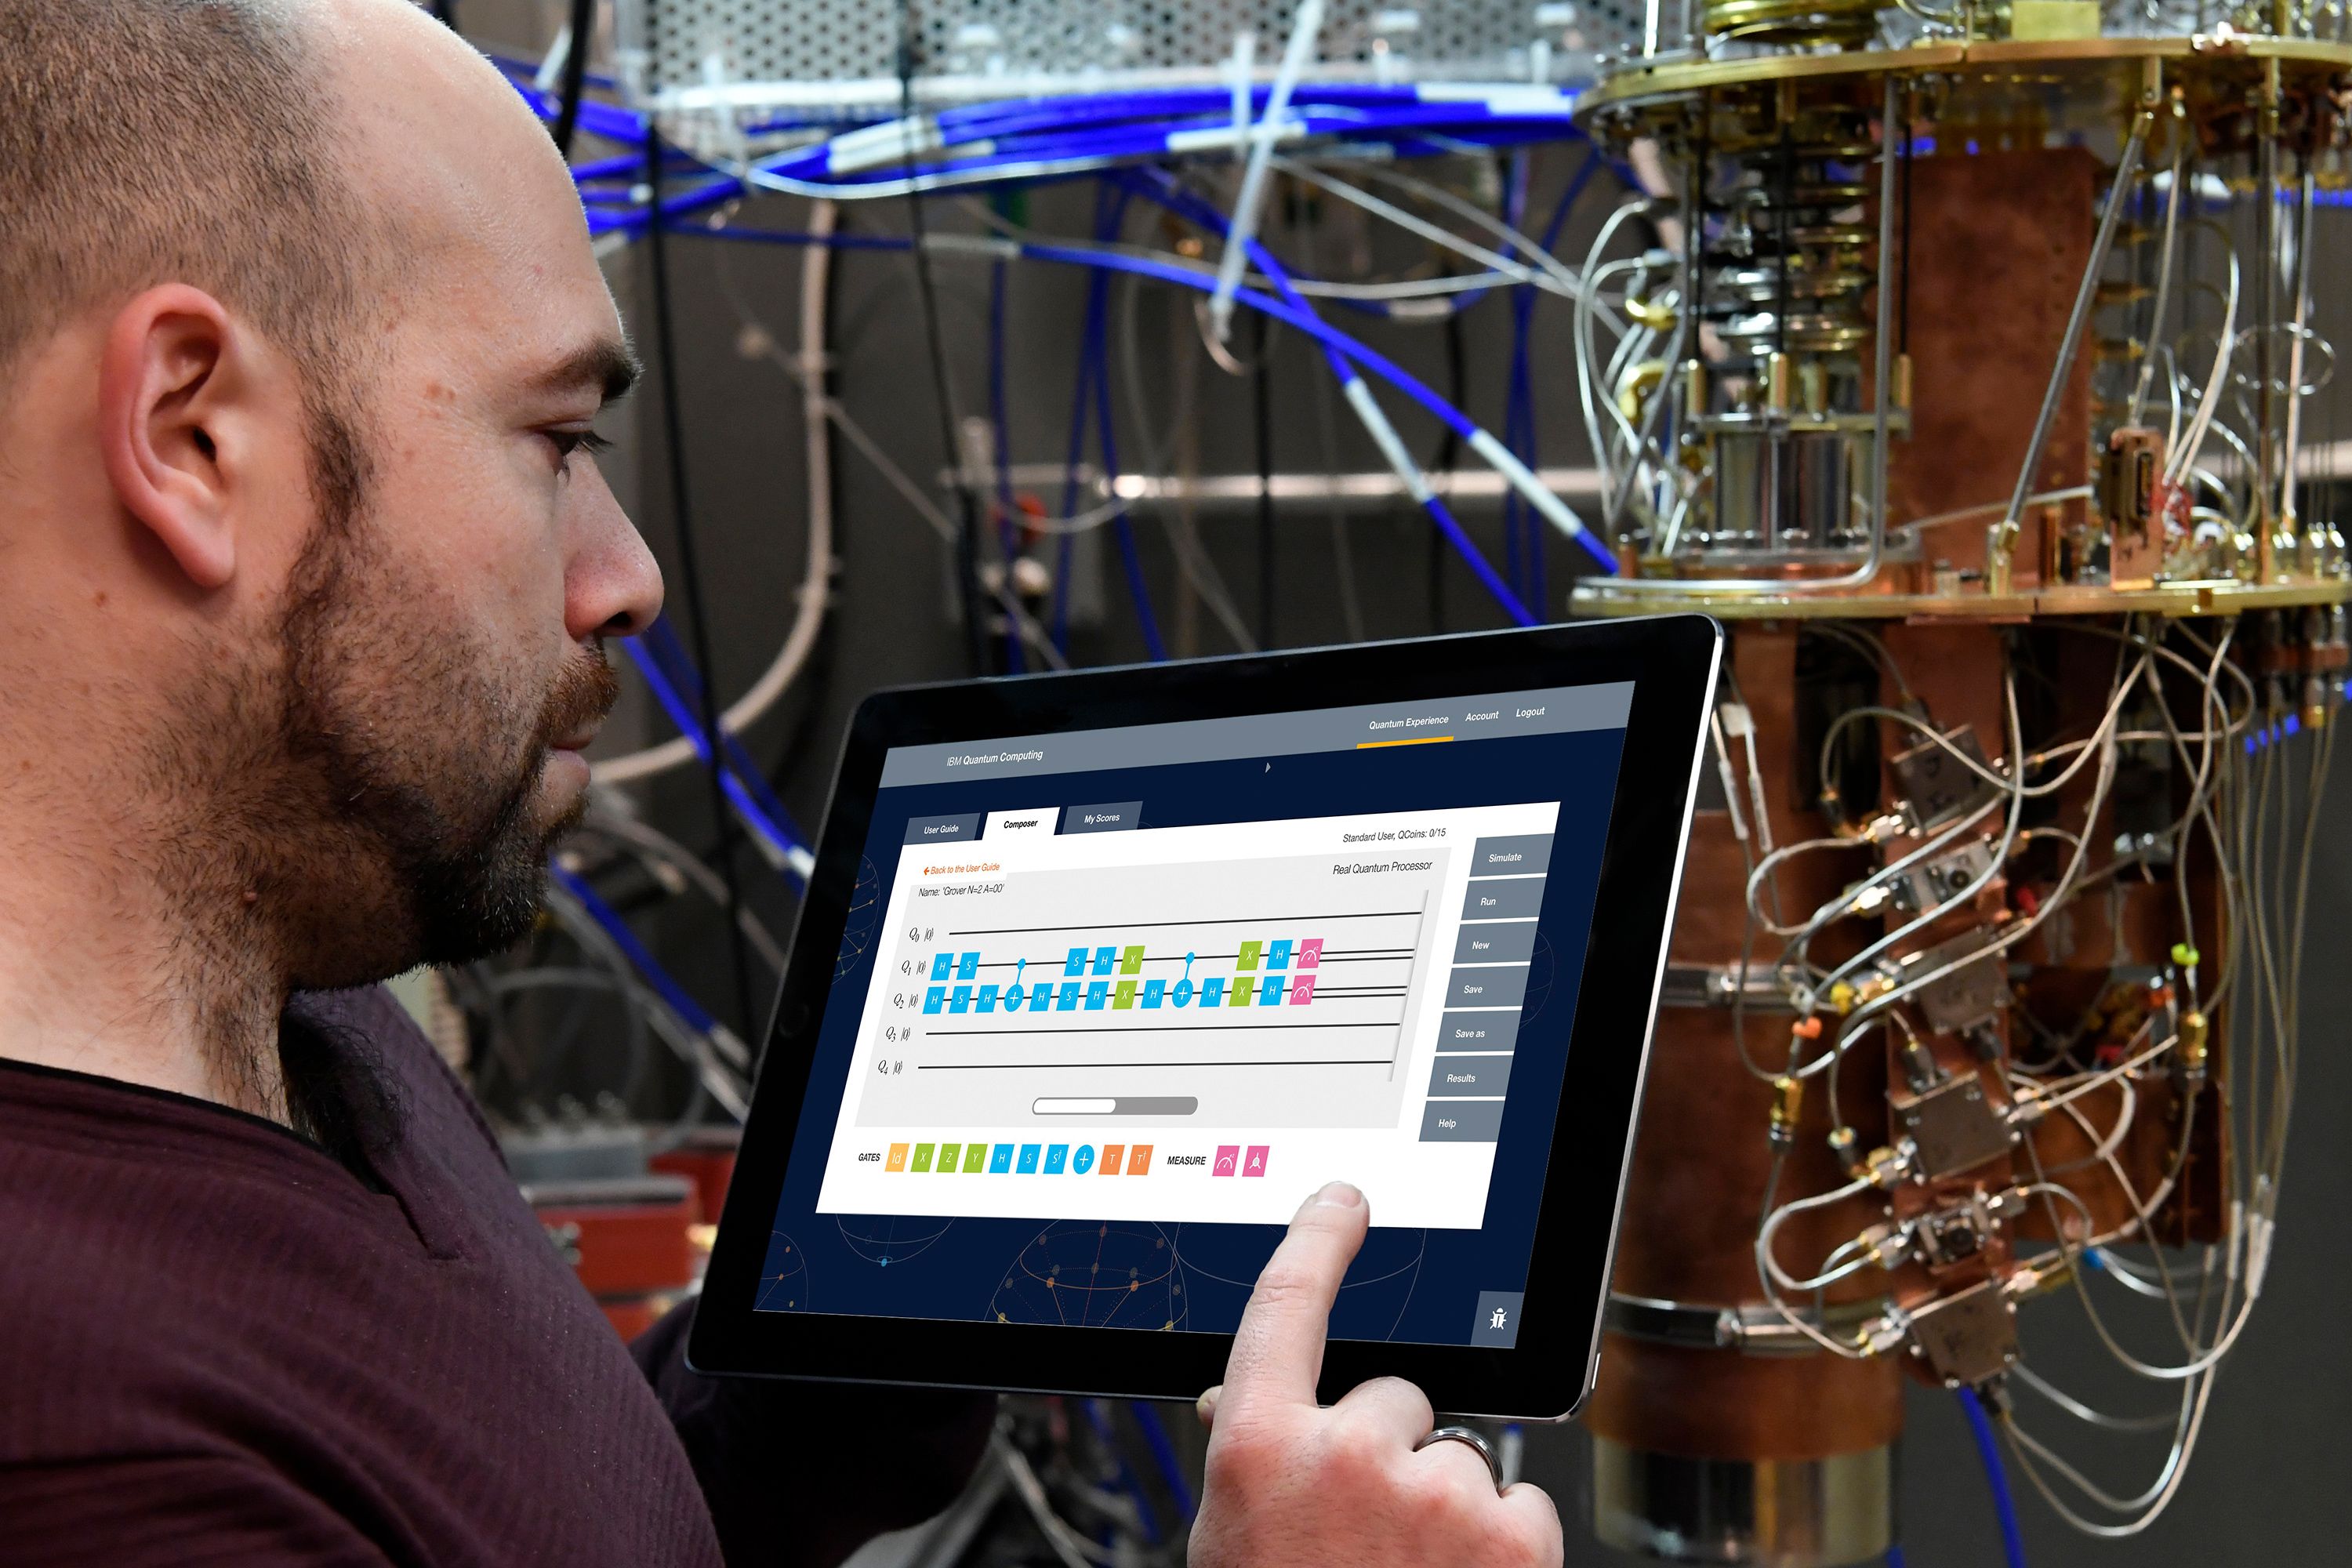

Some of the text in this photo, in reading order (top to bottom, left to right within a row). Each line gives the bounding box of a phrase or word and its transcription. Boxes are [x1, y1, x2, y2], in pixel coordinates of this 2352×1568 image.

[1465, 710, 1499, 721] Account
[1516, 706, 1545, 719] Logout
[1369, 715, 1449, 730] Quantum Experience
[946, 750, 1044, 767] IBM Quantum Computing
[1004, 819, 1038, 831] Composer
[1084, 814, 1120, 824] My Scores
[1343, 828, 1446, 842] Standard User, QCoins: 0/15
[1489, 853, 1522, 862] Simulate
[931, 863, 1000, 875] Back to the User Guide
[1333, 862, 1432, 875] Real Quantum Processor
[919, 887, 940, 897] Name:
[967, 884, 982, 895] N=2
[1481, 897, 1496, 906] Run
[1472, 941, 1490, 949] New
[939, 962, 946, 971] H
[966, 961, 971, 970] S
[1074, 957, 1079, 966] S
[1102, 956, 1108, 965] H
[1129, 955, 1136, 964] X
[1246, 951, 1253, 960] X
[1277, 949, 1283, 959] H
[931, 996, 938, 1004] H
[959, 995, 964, 1004] S
[984, 994, 991, 1003] H
[1038, 993, 1044, 1002] H
[1066, 992, 1072, 1000] S
[1094, 991, 1100, 1000] H
[1122, 990, 1128, 1000] X
[1150, 989, 1157, 998] H
[1209, 988, 1215, 996] H
[1239, 987, 1245, 996] X
[1269, 986, 1276, 995] H
[1464, 985, 1483, 994] Save
[1455, 1029, 1474, 1038] Save
[1447, 1073, 1475, 1083] Results
[1439, 1119, 1456, 1129] Help
[858, 1153, 880, 1162] GATES
[920, 1152, 927, 1163] X
[946, 1152, 951, 1163] Z
[973, 1153, 978, 1163] Y
[999, 1154, 1005, 1163] H
[1026, 1154, 1032, 1163] S
[1109, 1154, 1115, 1164] T
[1167, 1156, 1206, 1166] MEASURE
